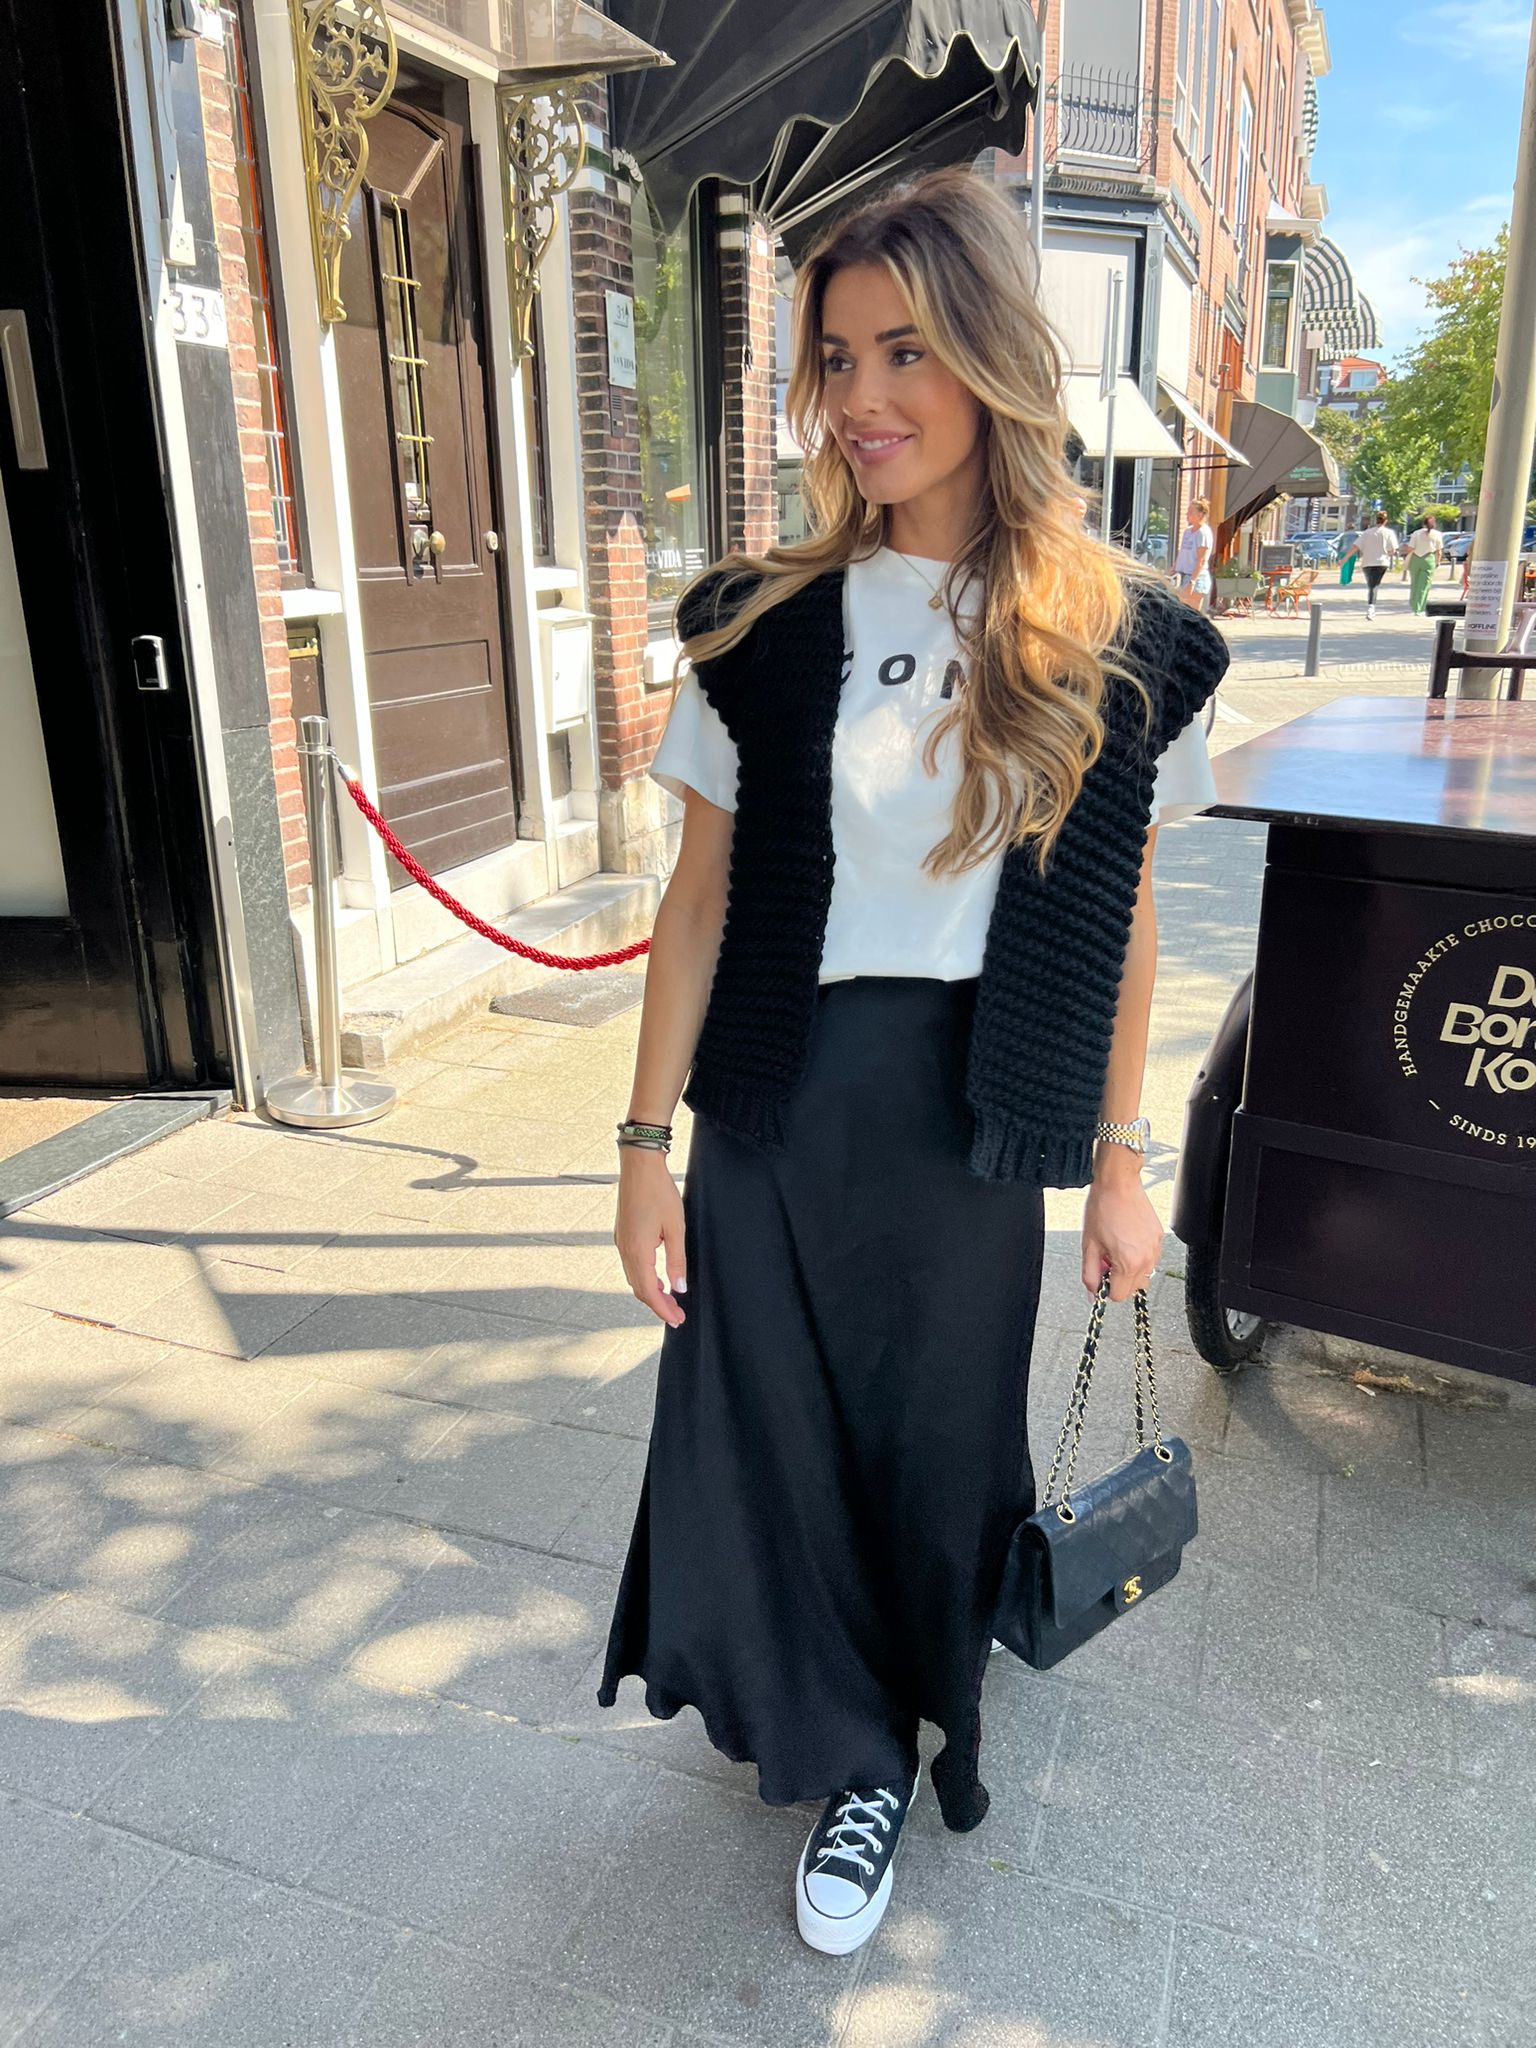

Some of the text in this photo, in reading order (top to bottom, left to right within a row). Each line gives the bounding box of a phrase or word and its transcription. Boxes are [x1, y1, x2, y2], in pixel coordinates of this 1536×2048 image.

[1393, 933, 1460, 1077] HANDGEMAAKTE
[1487, 965, 1536, 1008] D
[1440, 1002, 1536, 1049] Bor
[1449, 1114, 1508, 1146] SINDS
